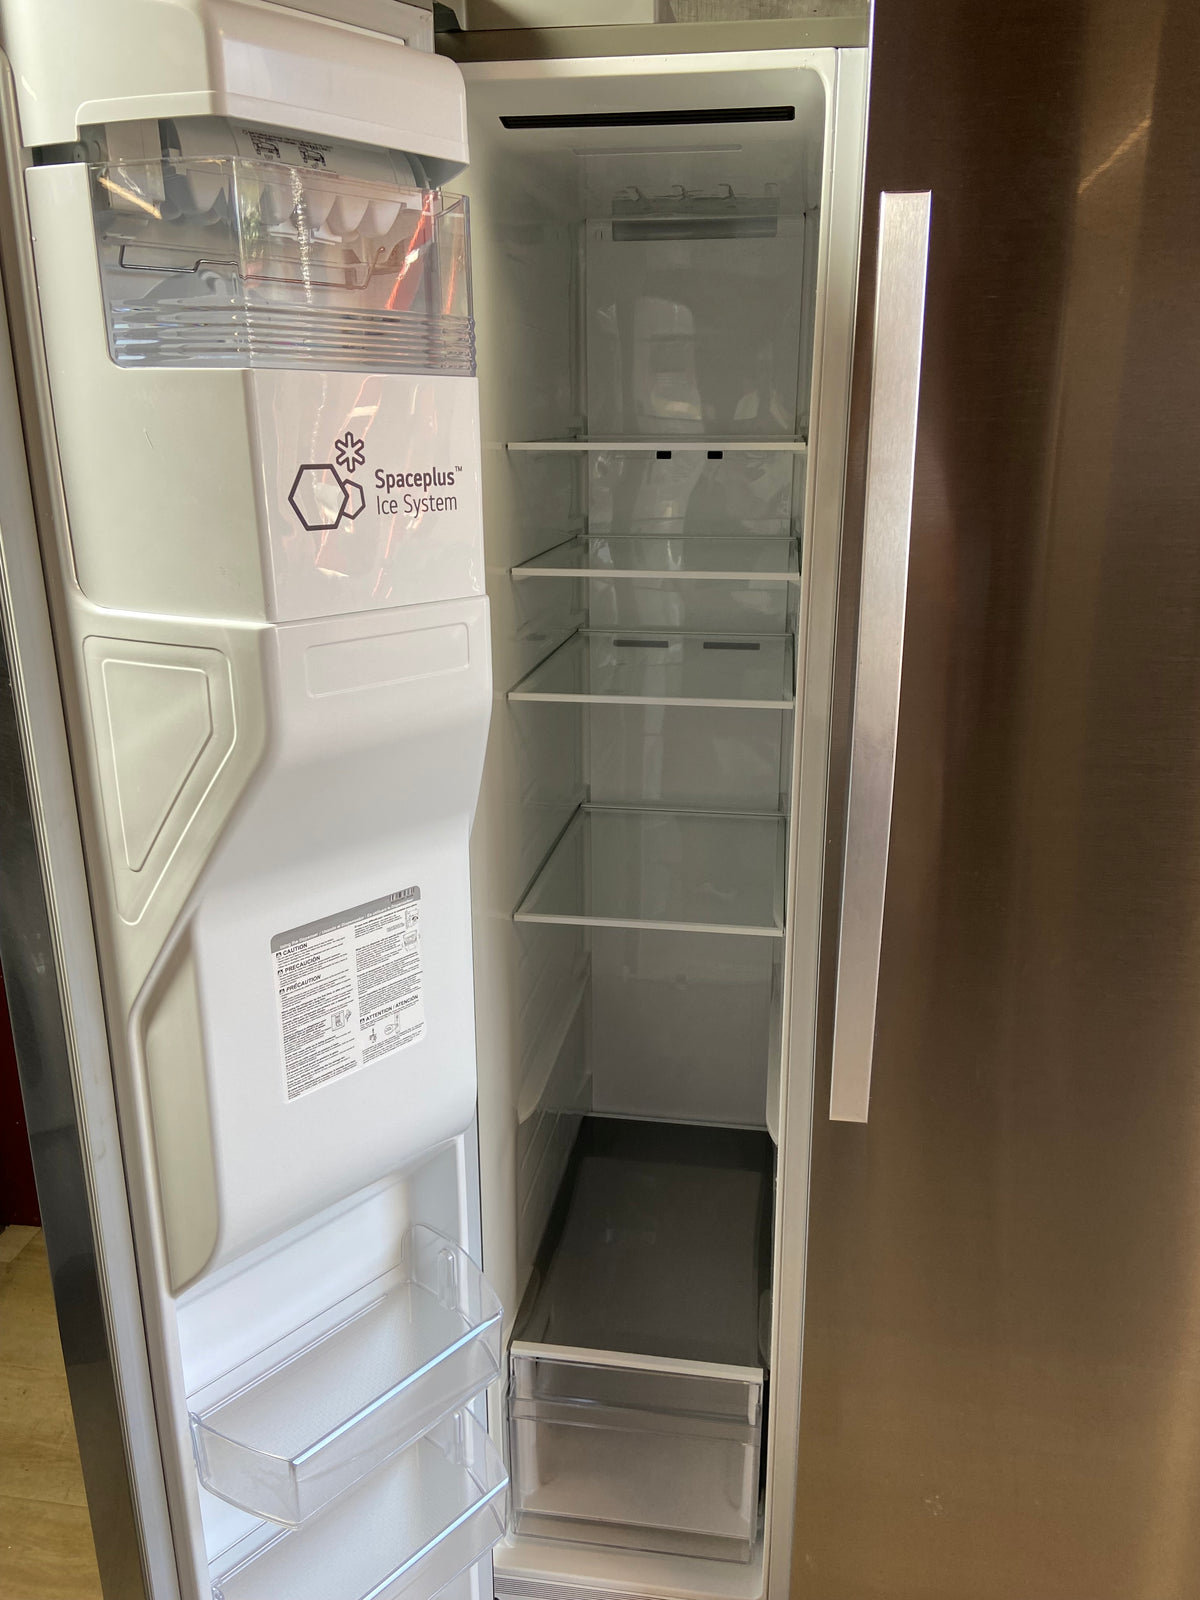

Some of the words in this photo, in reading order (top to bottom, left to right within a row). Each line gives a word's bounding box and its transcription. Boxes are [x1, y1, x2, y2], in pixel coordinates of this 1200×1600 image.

[376, 495, 398, 515] Ice
[403, 493, 457, 519] System
[282, 942, 308, 956] CAUTION
[365, 1006, 393, 1021] ATTENTION
